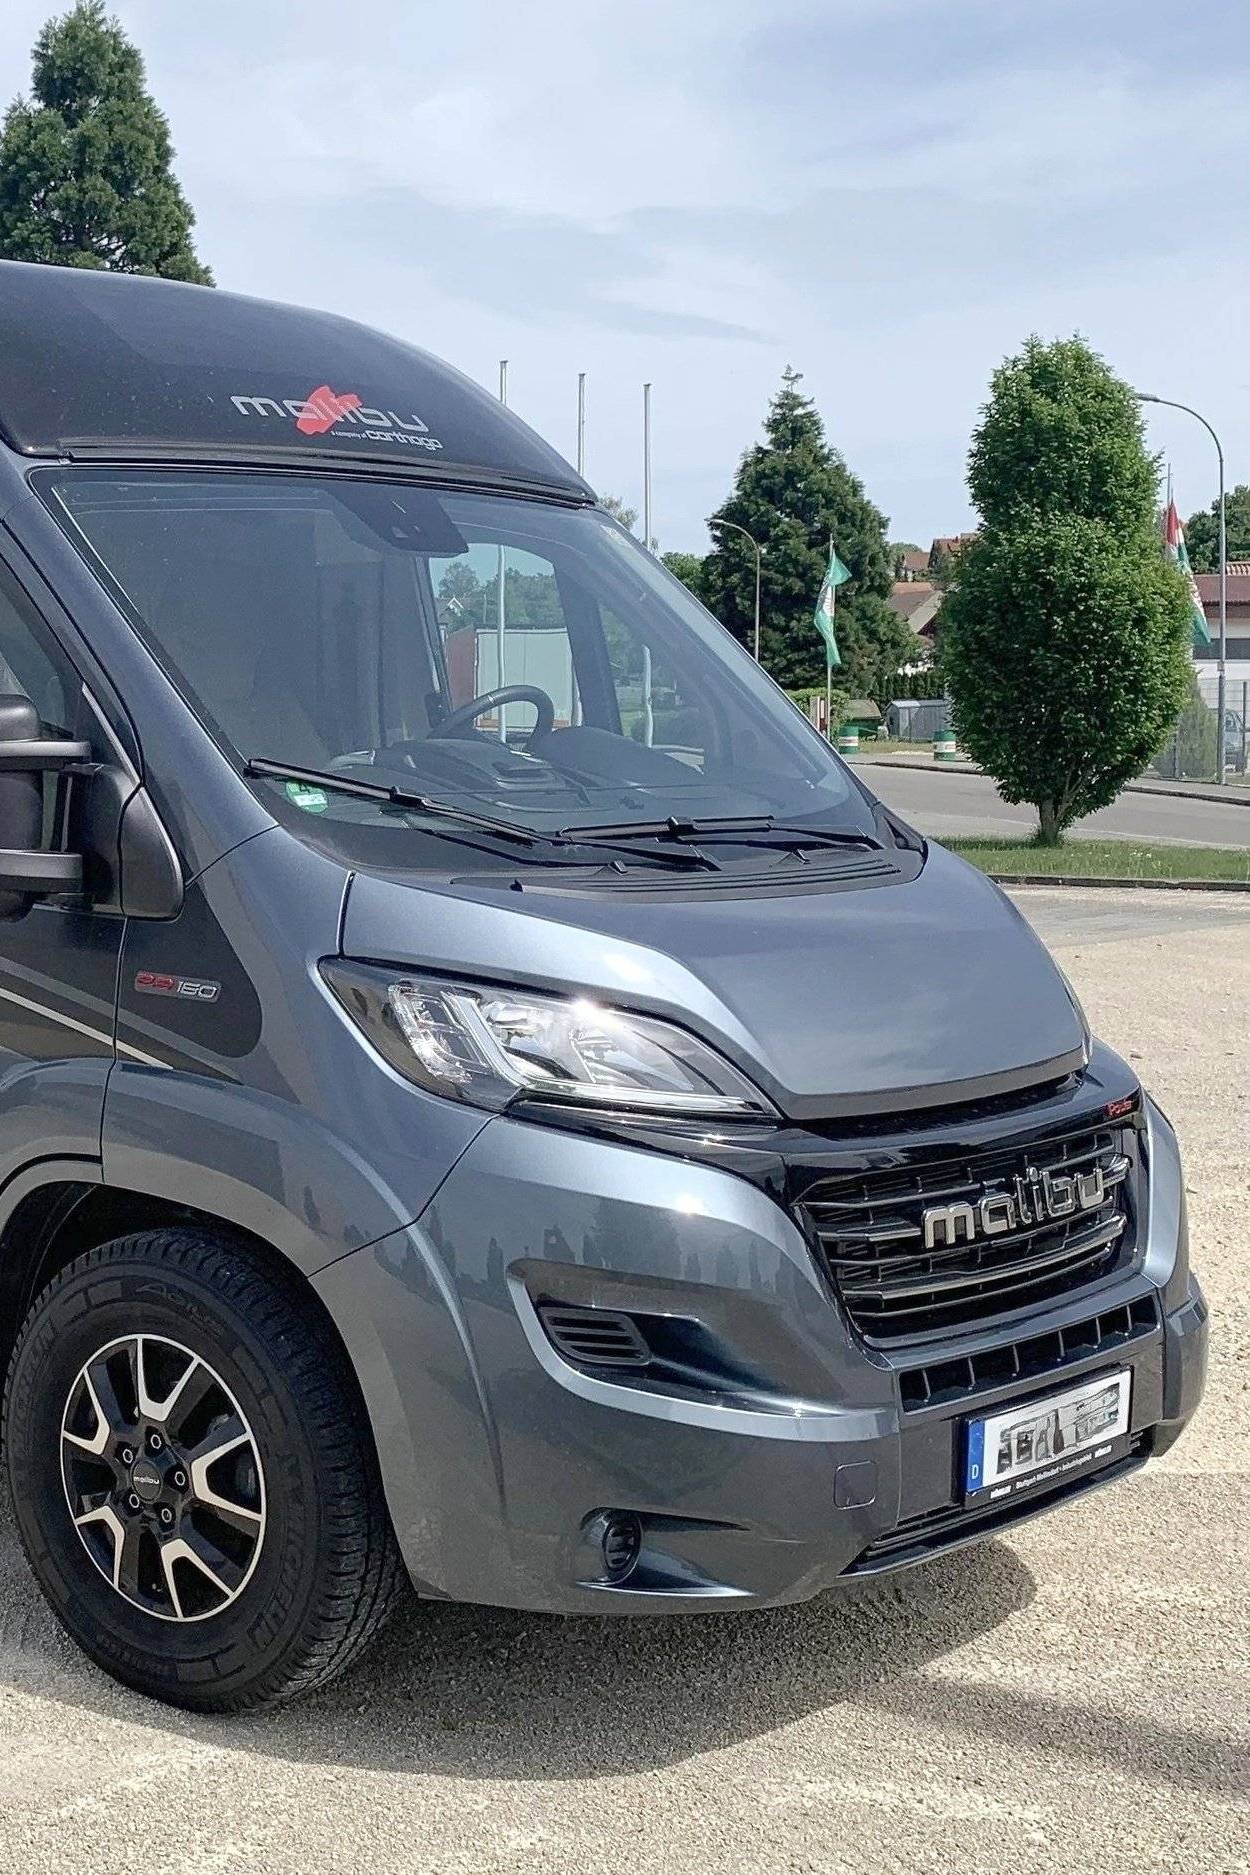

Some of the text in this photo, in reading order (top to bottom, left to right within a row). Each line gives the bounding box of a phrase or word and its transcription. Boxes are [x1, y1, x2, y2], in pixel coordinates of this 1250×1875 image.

[230, 395, 430, 433] malibu
[366, 430, 444, 451] carthago
[922, 1165, 1105, 1250] malibu
[971, 1464, 980, 1480] D
